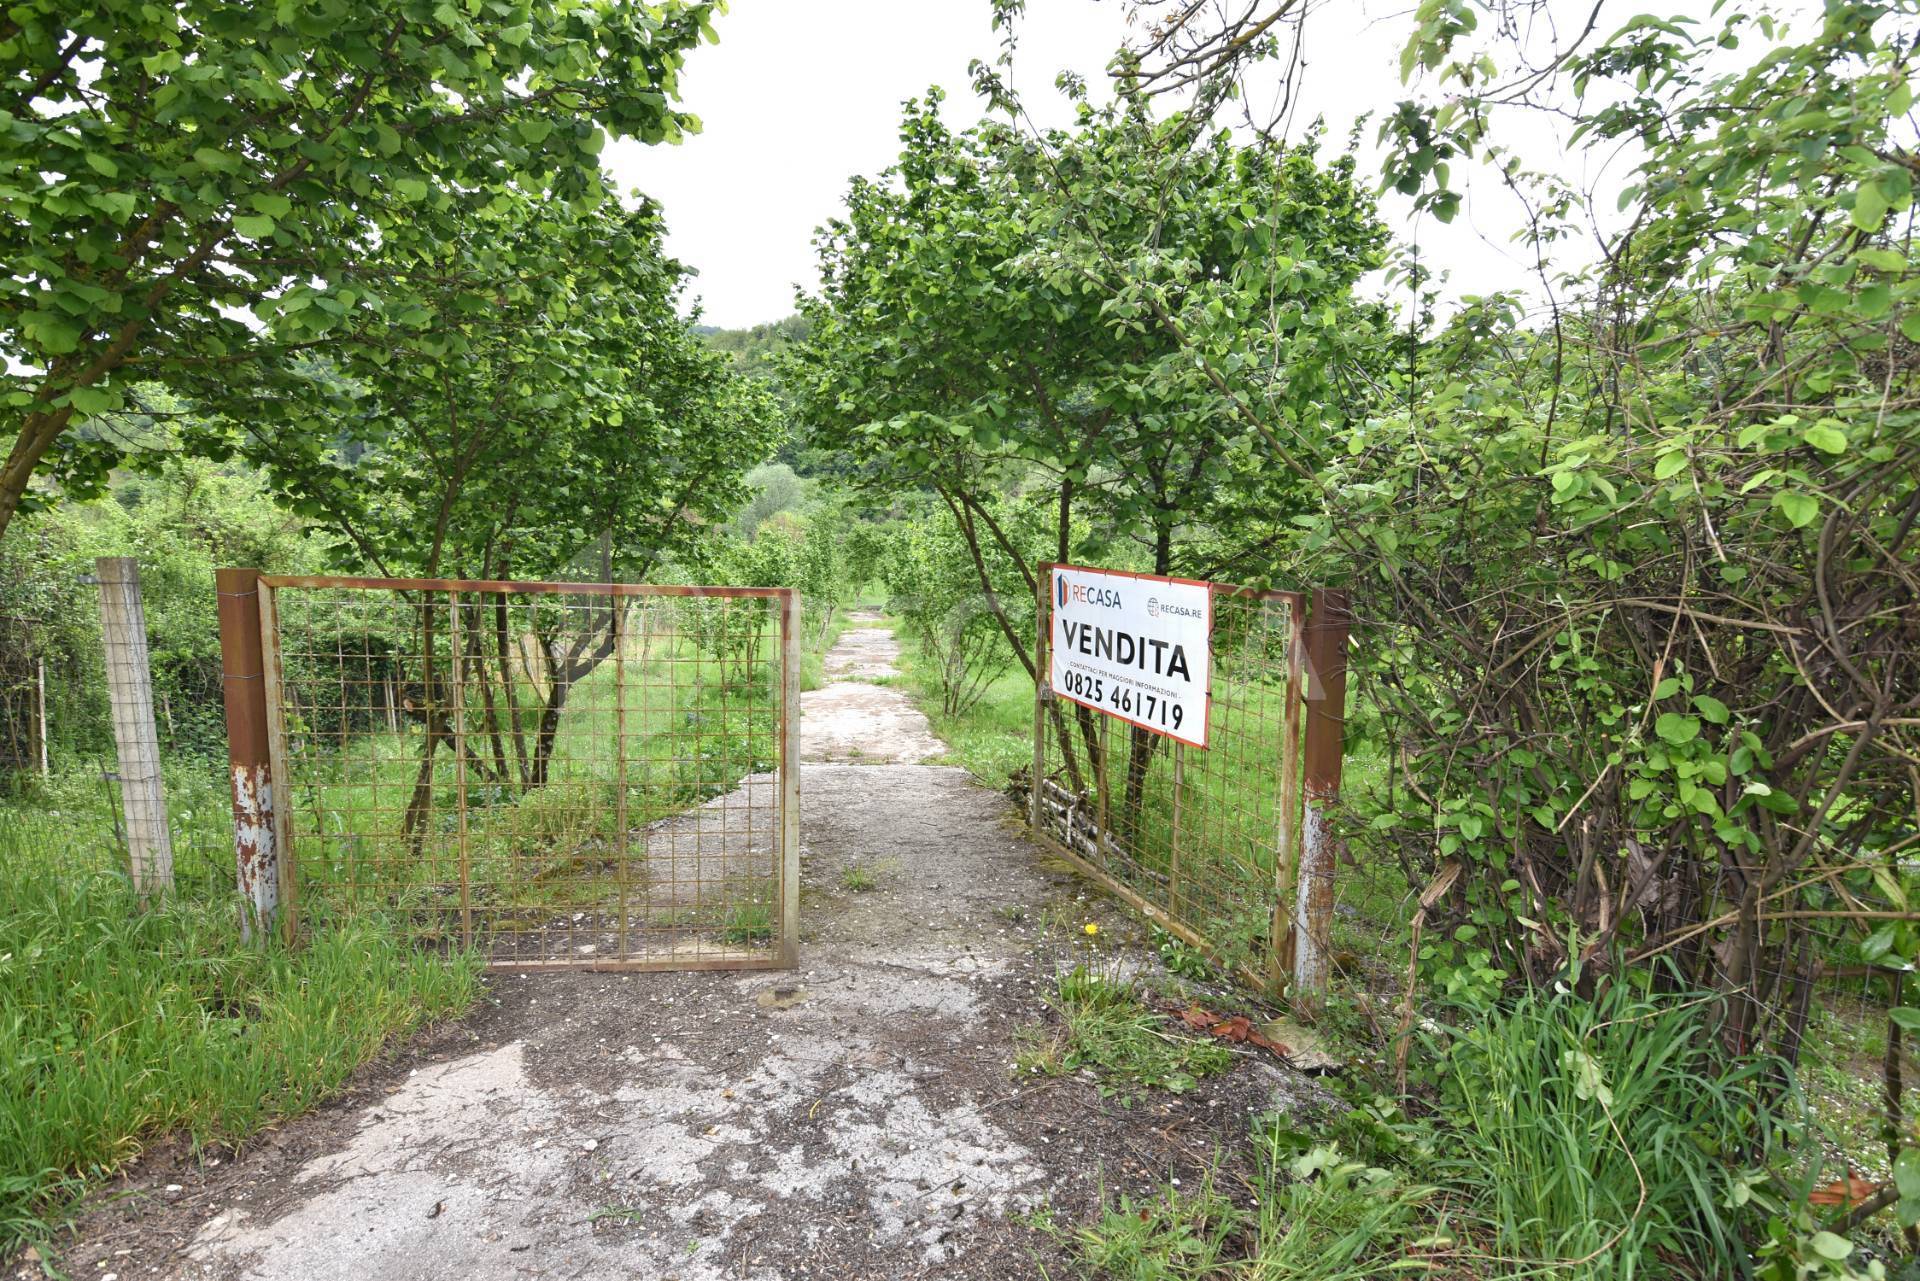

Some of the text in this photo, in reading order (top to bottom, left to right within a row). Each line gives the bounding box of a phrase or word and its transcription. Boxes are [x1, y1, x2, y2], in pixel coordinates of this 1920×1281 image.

[1073, 584, 1122, 610] RECASA
[1160, 604, 1202, 619] RECASA.RE
[1062, 619, 1191, 683] VENDITA
[1070, 661, 1098, 675] CONTATTACI
[1098, 669, 1108, 679] PER
[1109, 674, 1134, 686] MAGGIORI
[1135, 681, 1178, 699] INFORMAZIONI
[1064, 670, 1183, 731] 0825 461719
